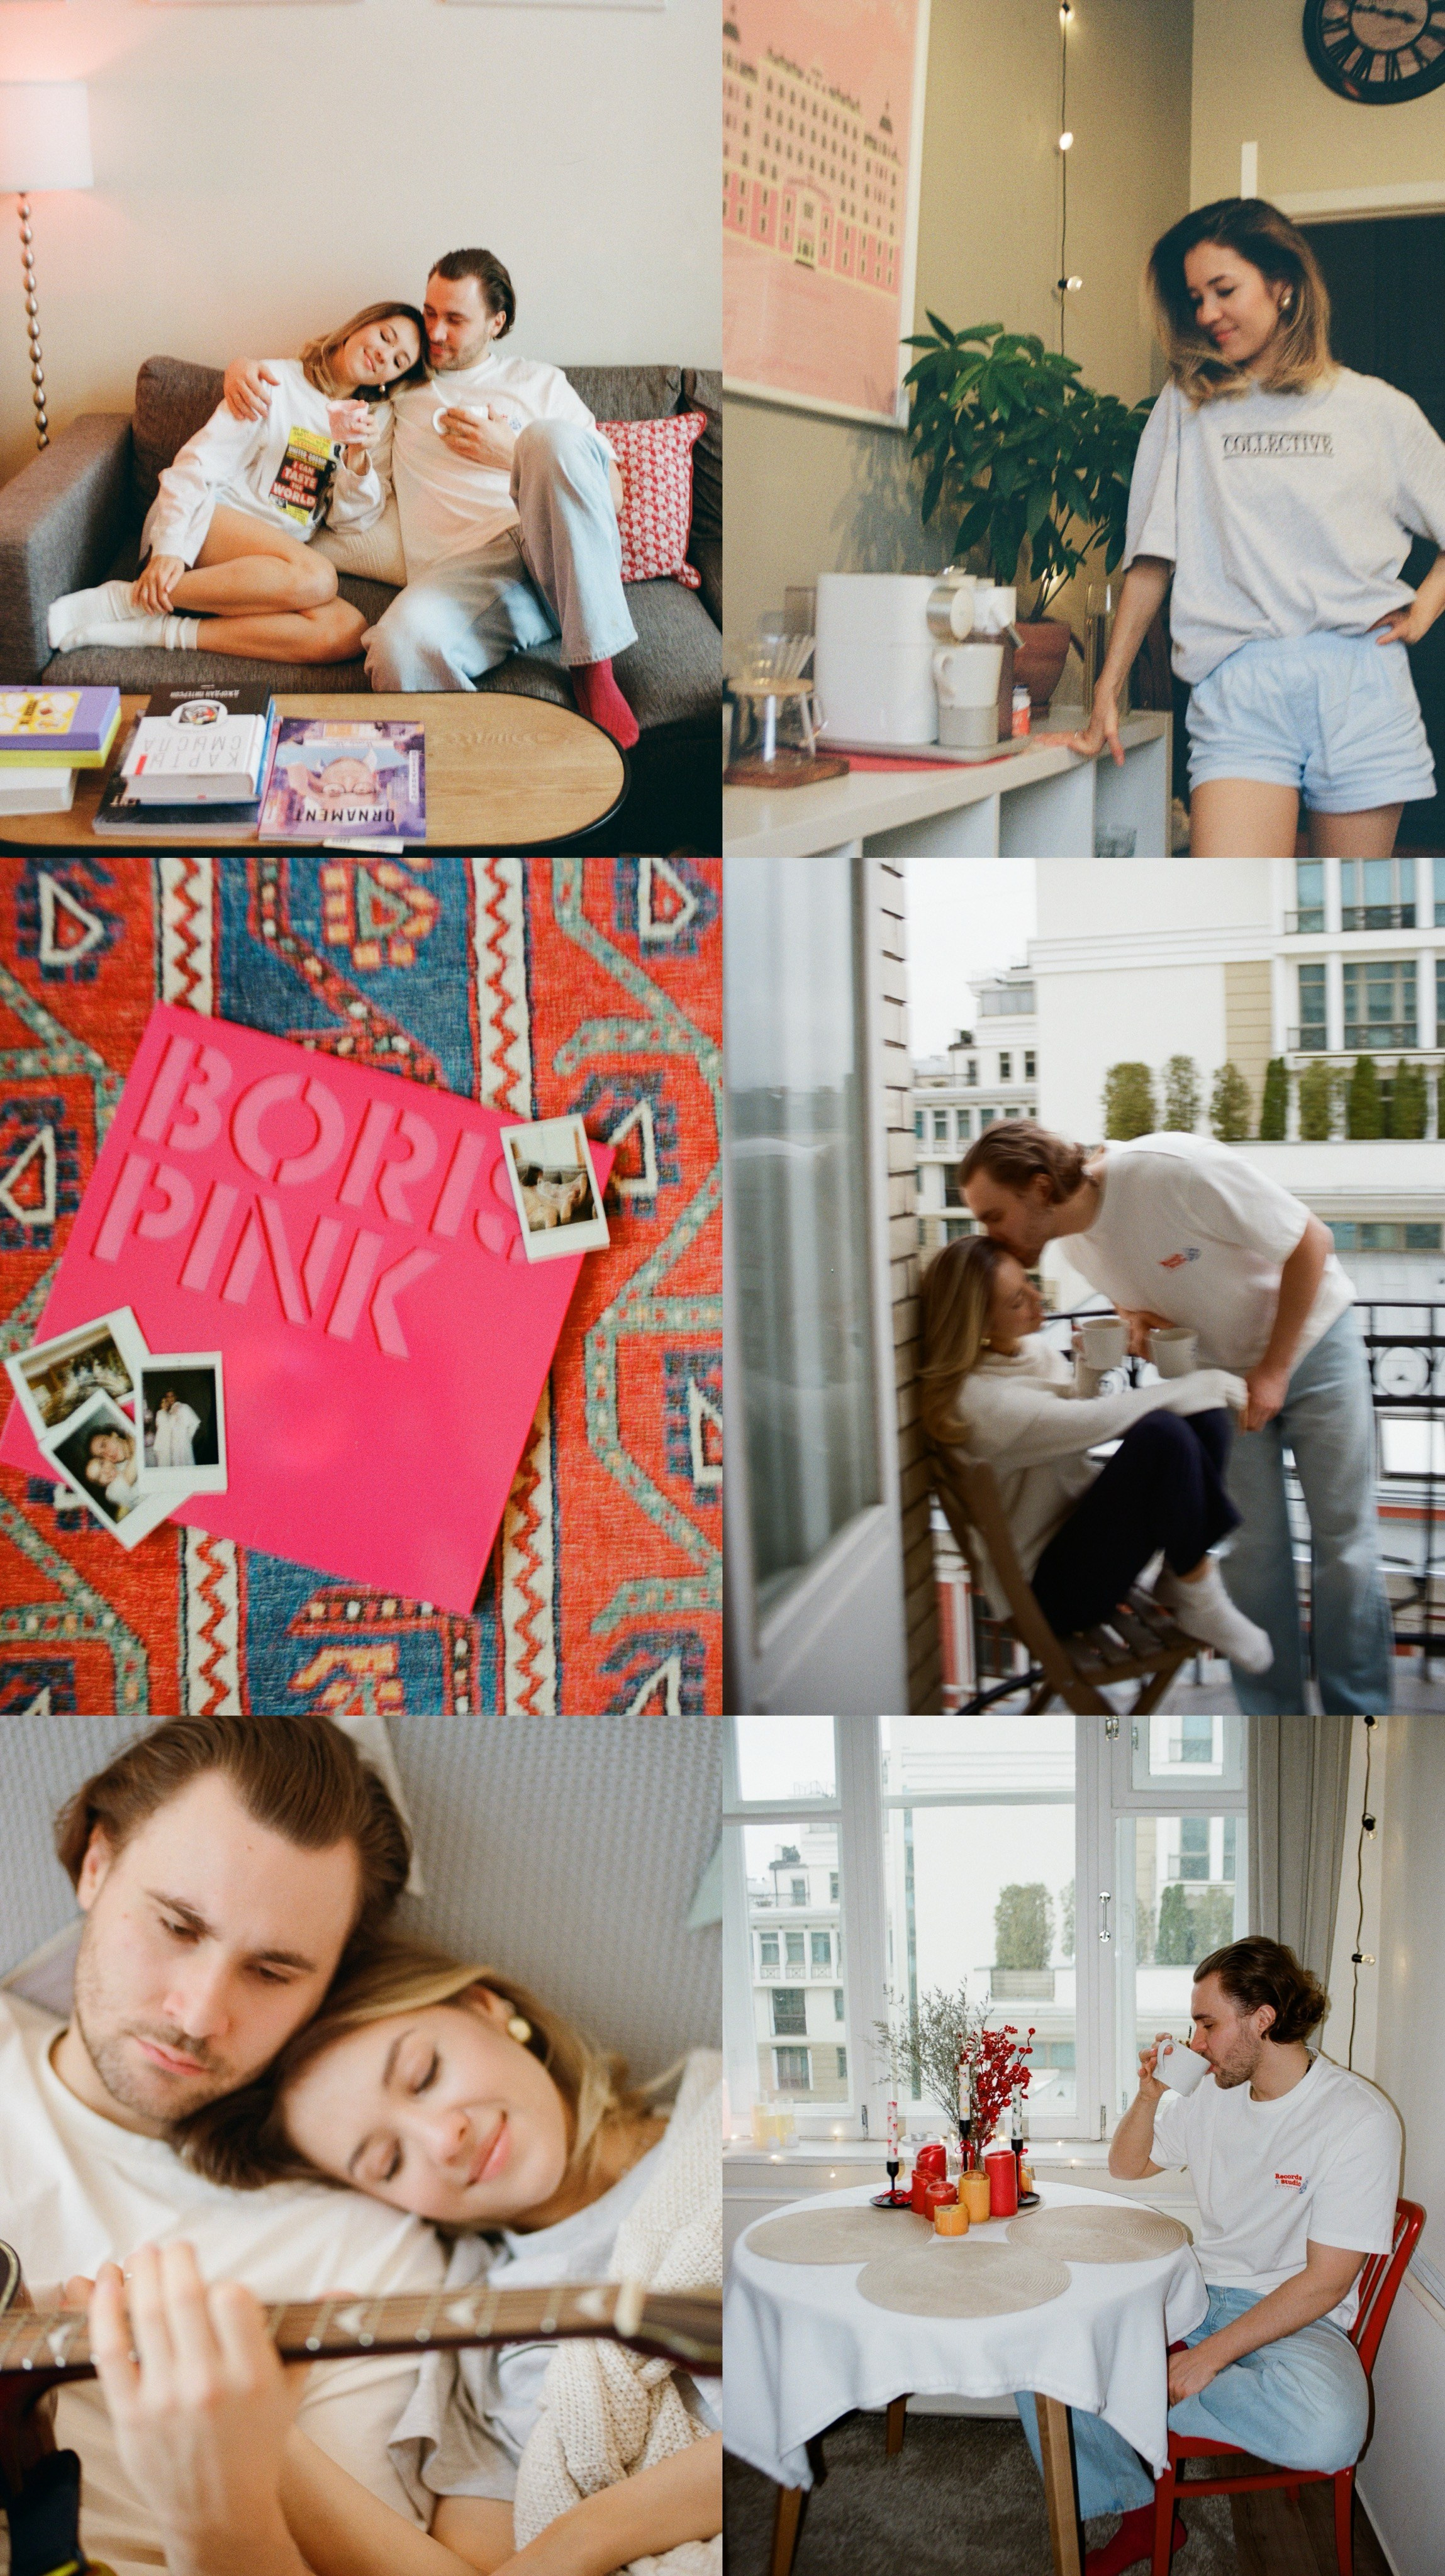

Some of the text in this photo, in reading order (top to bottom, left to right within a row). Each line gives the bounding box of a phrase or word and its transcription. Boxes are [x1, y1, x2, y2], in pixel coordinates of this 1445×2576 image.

[1224, 434, 1333, 453] COLLECTIVE
[284, 467, 318, 489] TASTE
[274, 482, 316, 507] WORLD
[144, 735, 242, 752] СМЫСЛА
[150, 752, 238, 769] КАРТЫ
[296, 808, 395, 822] ORNAMENT
[90, 1152, 439, 1361] PINK
